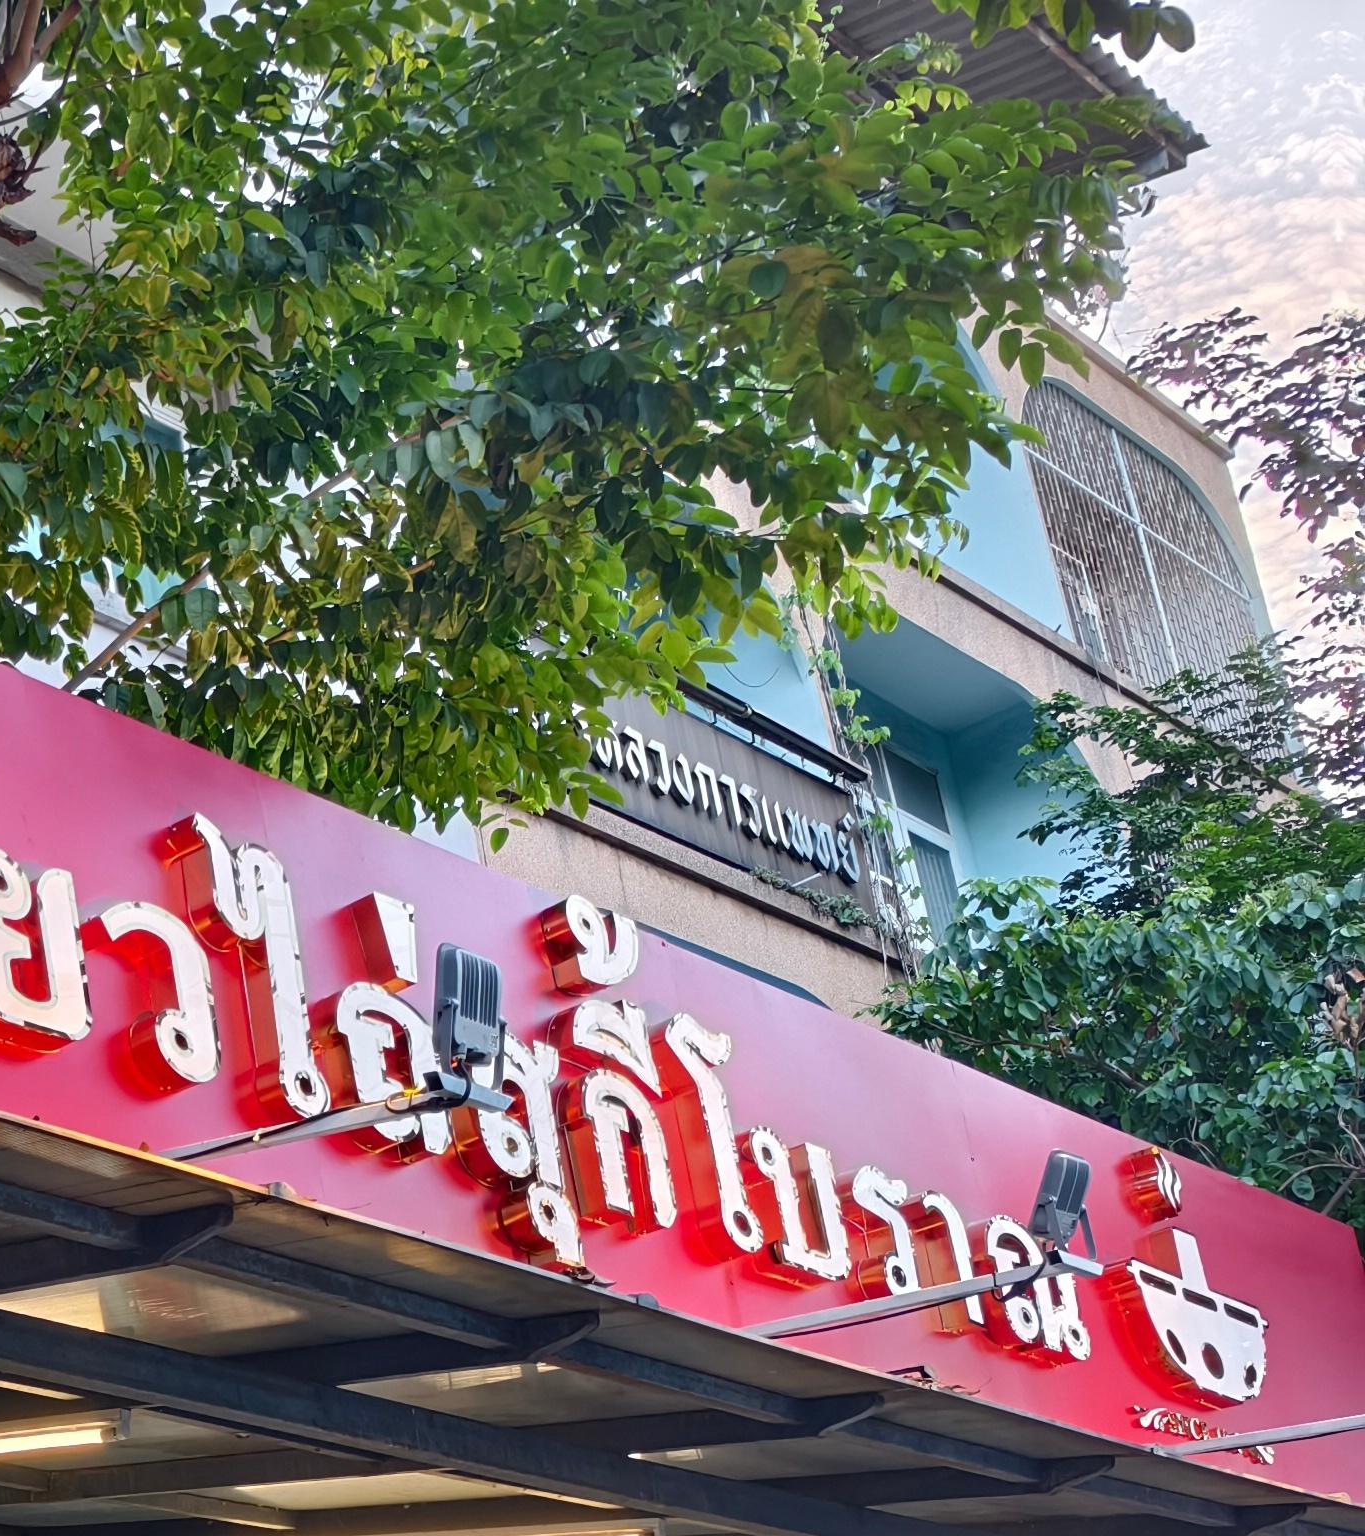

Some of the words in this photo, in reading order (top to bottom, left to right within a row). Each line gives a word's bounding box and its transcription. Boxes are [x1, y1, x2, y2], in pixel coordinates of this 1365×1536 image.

[531, 702, 861, 884] หลวงการแพทย์
